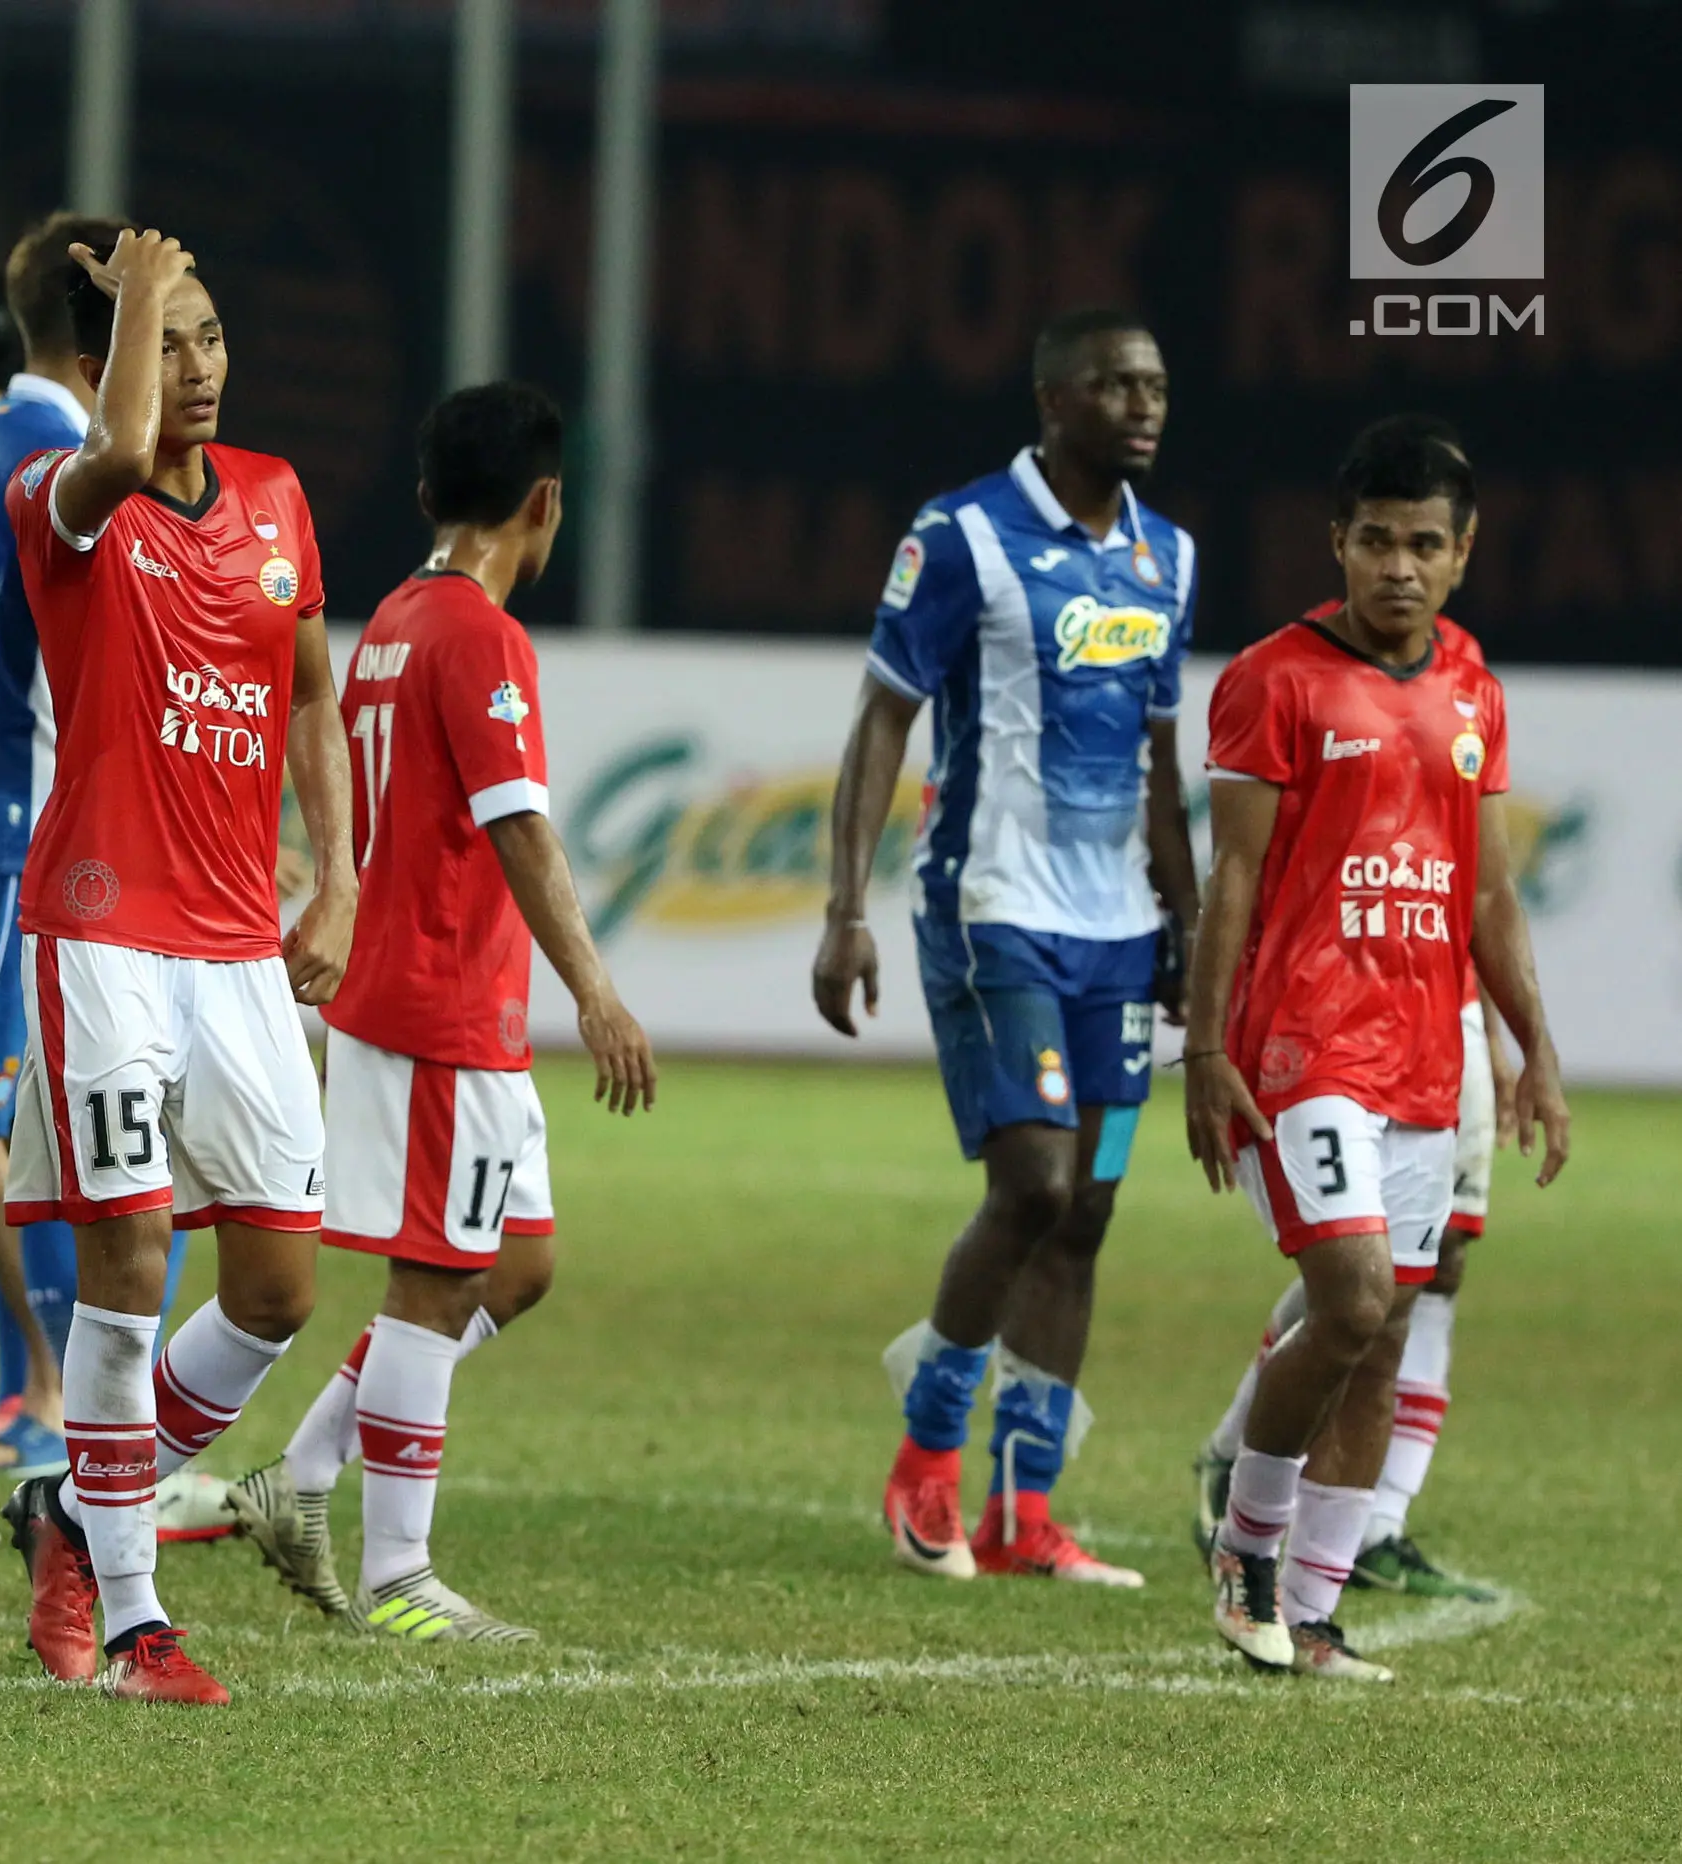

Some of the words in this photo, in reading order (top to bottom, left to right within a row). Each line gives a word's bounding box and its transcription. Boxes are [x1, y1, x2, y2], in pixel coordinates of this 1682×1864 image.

[1057, 598, 1169, 669] Giant
[205, 724, 266, 770] TOA
[1394, 900, 1450, 943] TOA
[86, 1089, 154, 1171] 15
[1309, 1126, 1348, 1197] 3
[461, 1157, 514, 1231] 17
